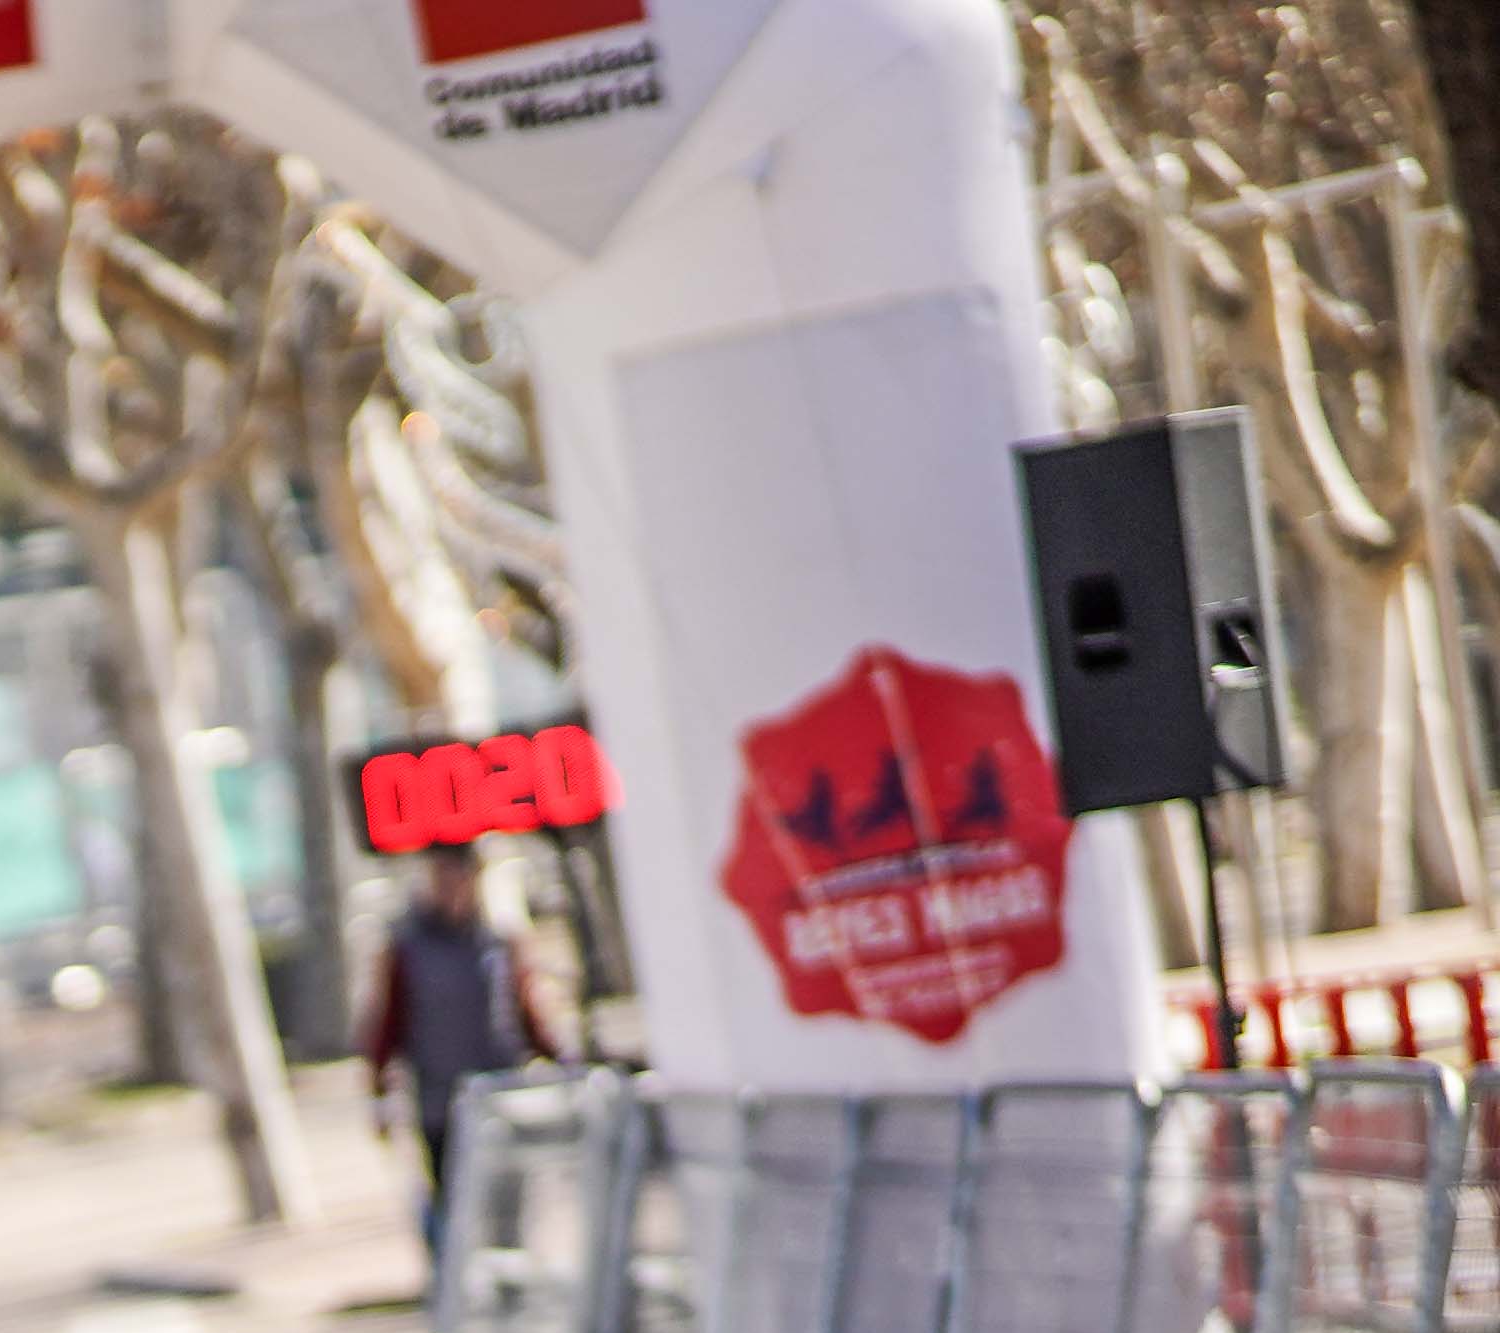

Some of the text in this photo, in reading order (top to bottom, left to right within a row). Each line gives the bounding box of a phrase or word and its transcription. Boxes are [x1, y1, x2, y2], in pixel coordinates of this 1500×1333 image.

[424, 40, 658, 105] Comunidad
[432, 72, 662, 139] de Madrid
